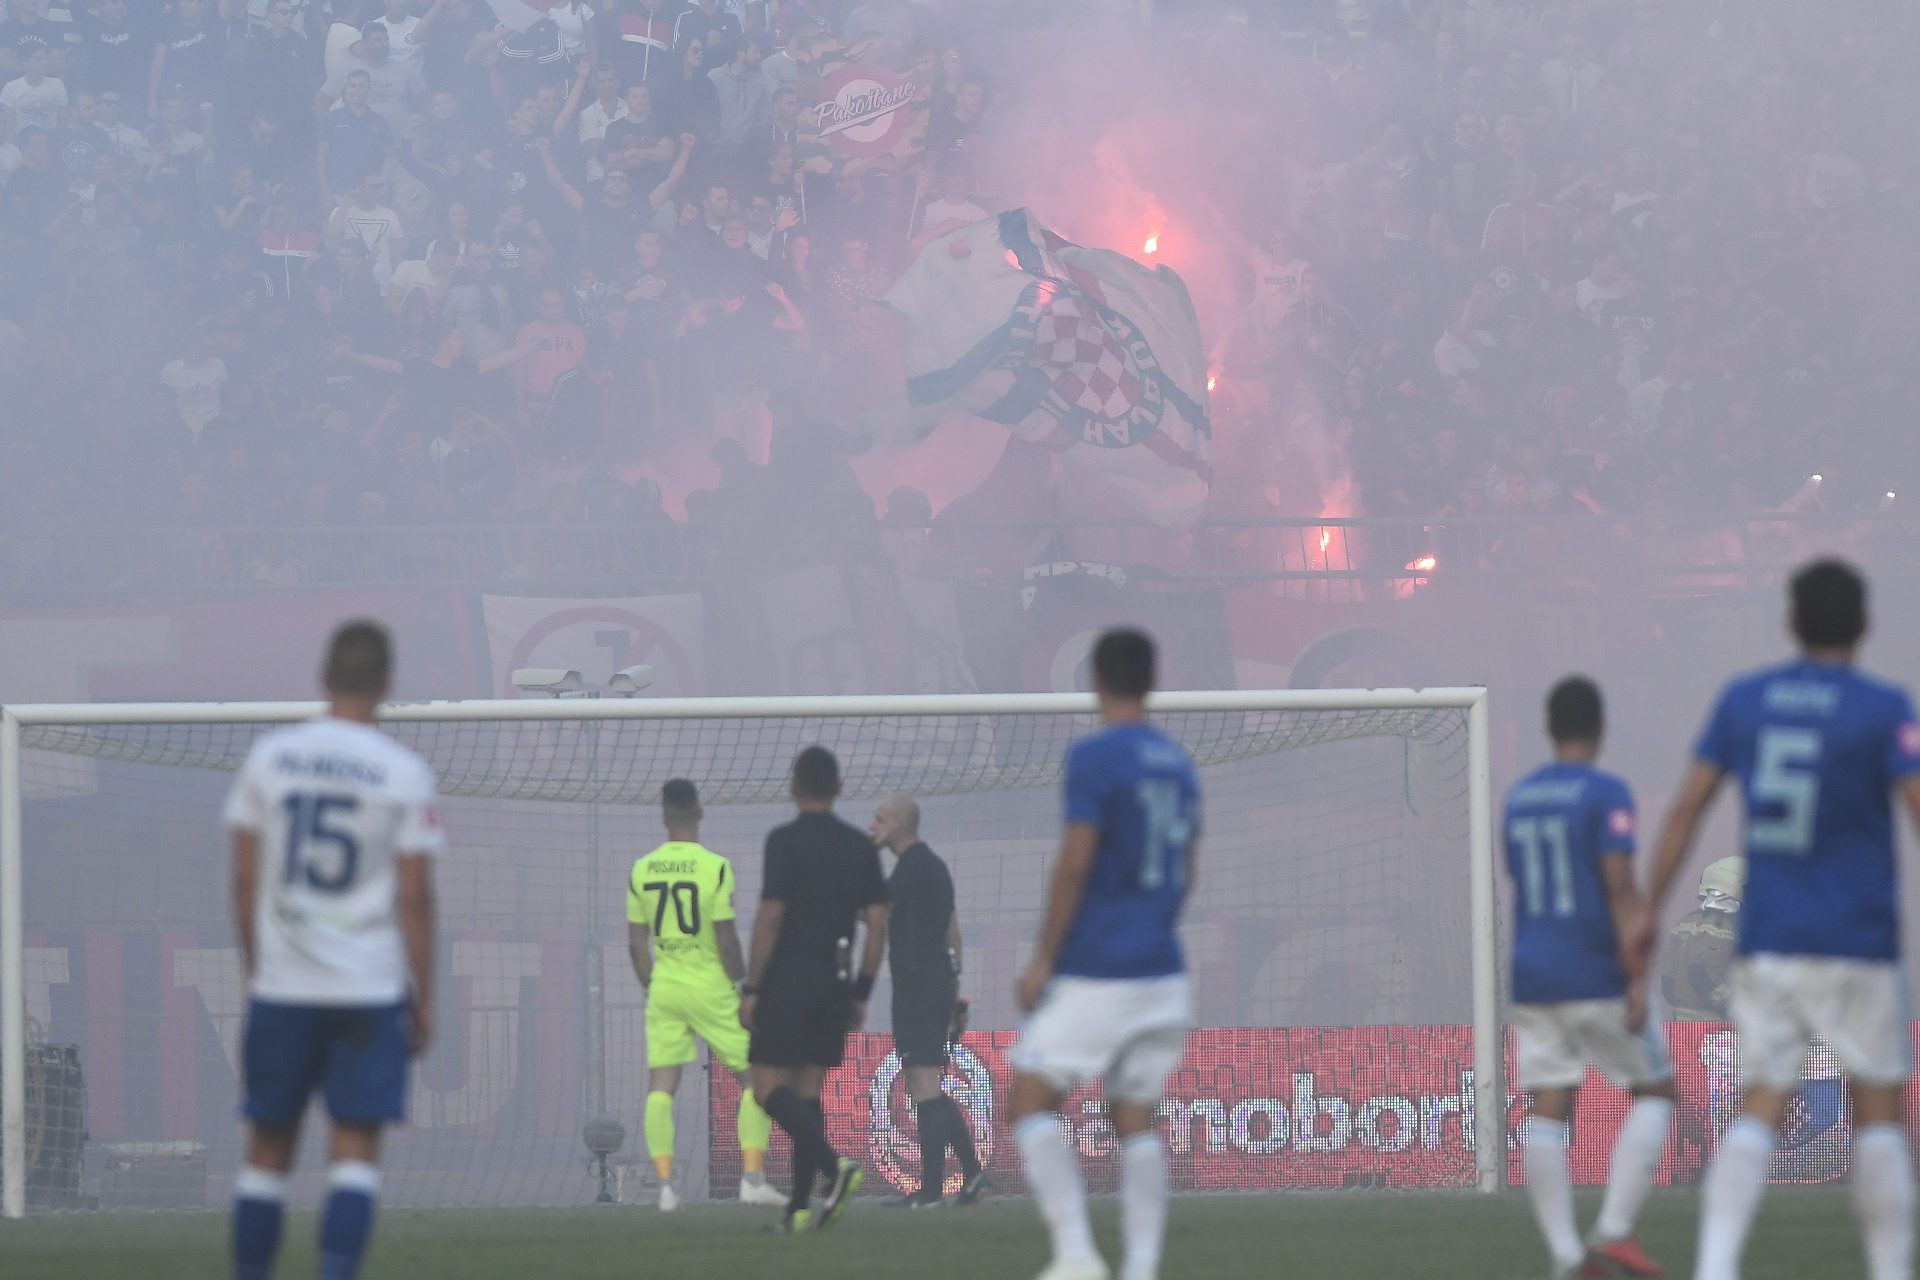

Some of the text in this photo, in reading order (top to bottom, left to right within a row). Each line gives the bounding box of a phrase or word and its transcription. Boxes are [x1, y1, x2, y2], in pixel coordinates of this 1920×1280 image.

[1749, 726, 1823, 856] 5
[283, 791, 361, 896] 15
[1509, 817, 1576, 918] 11
[643, 881, 701, 936] 70
